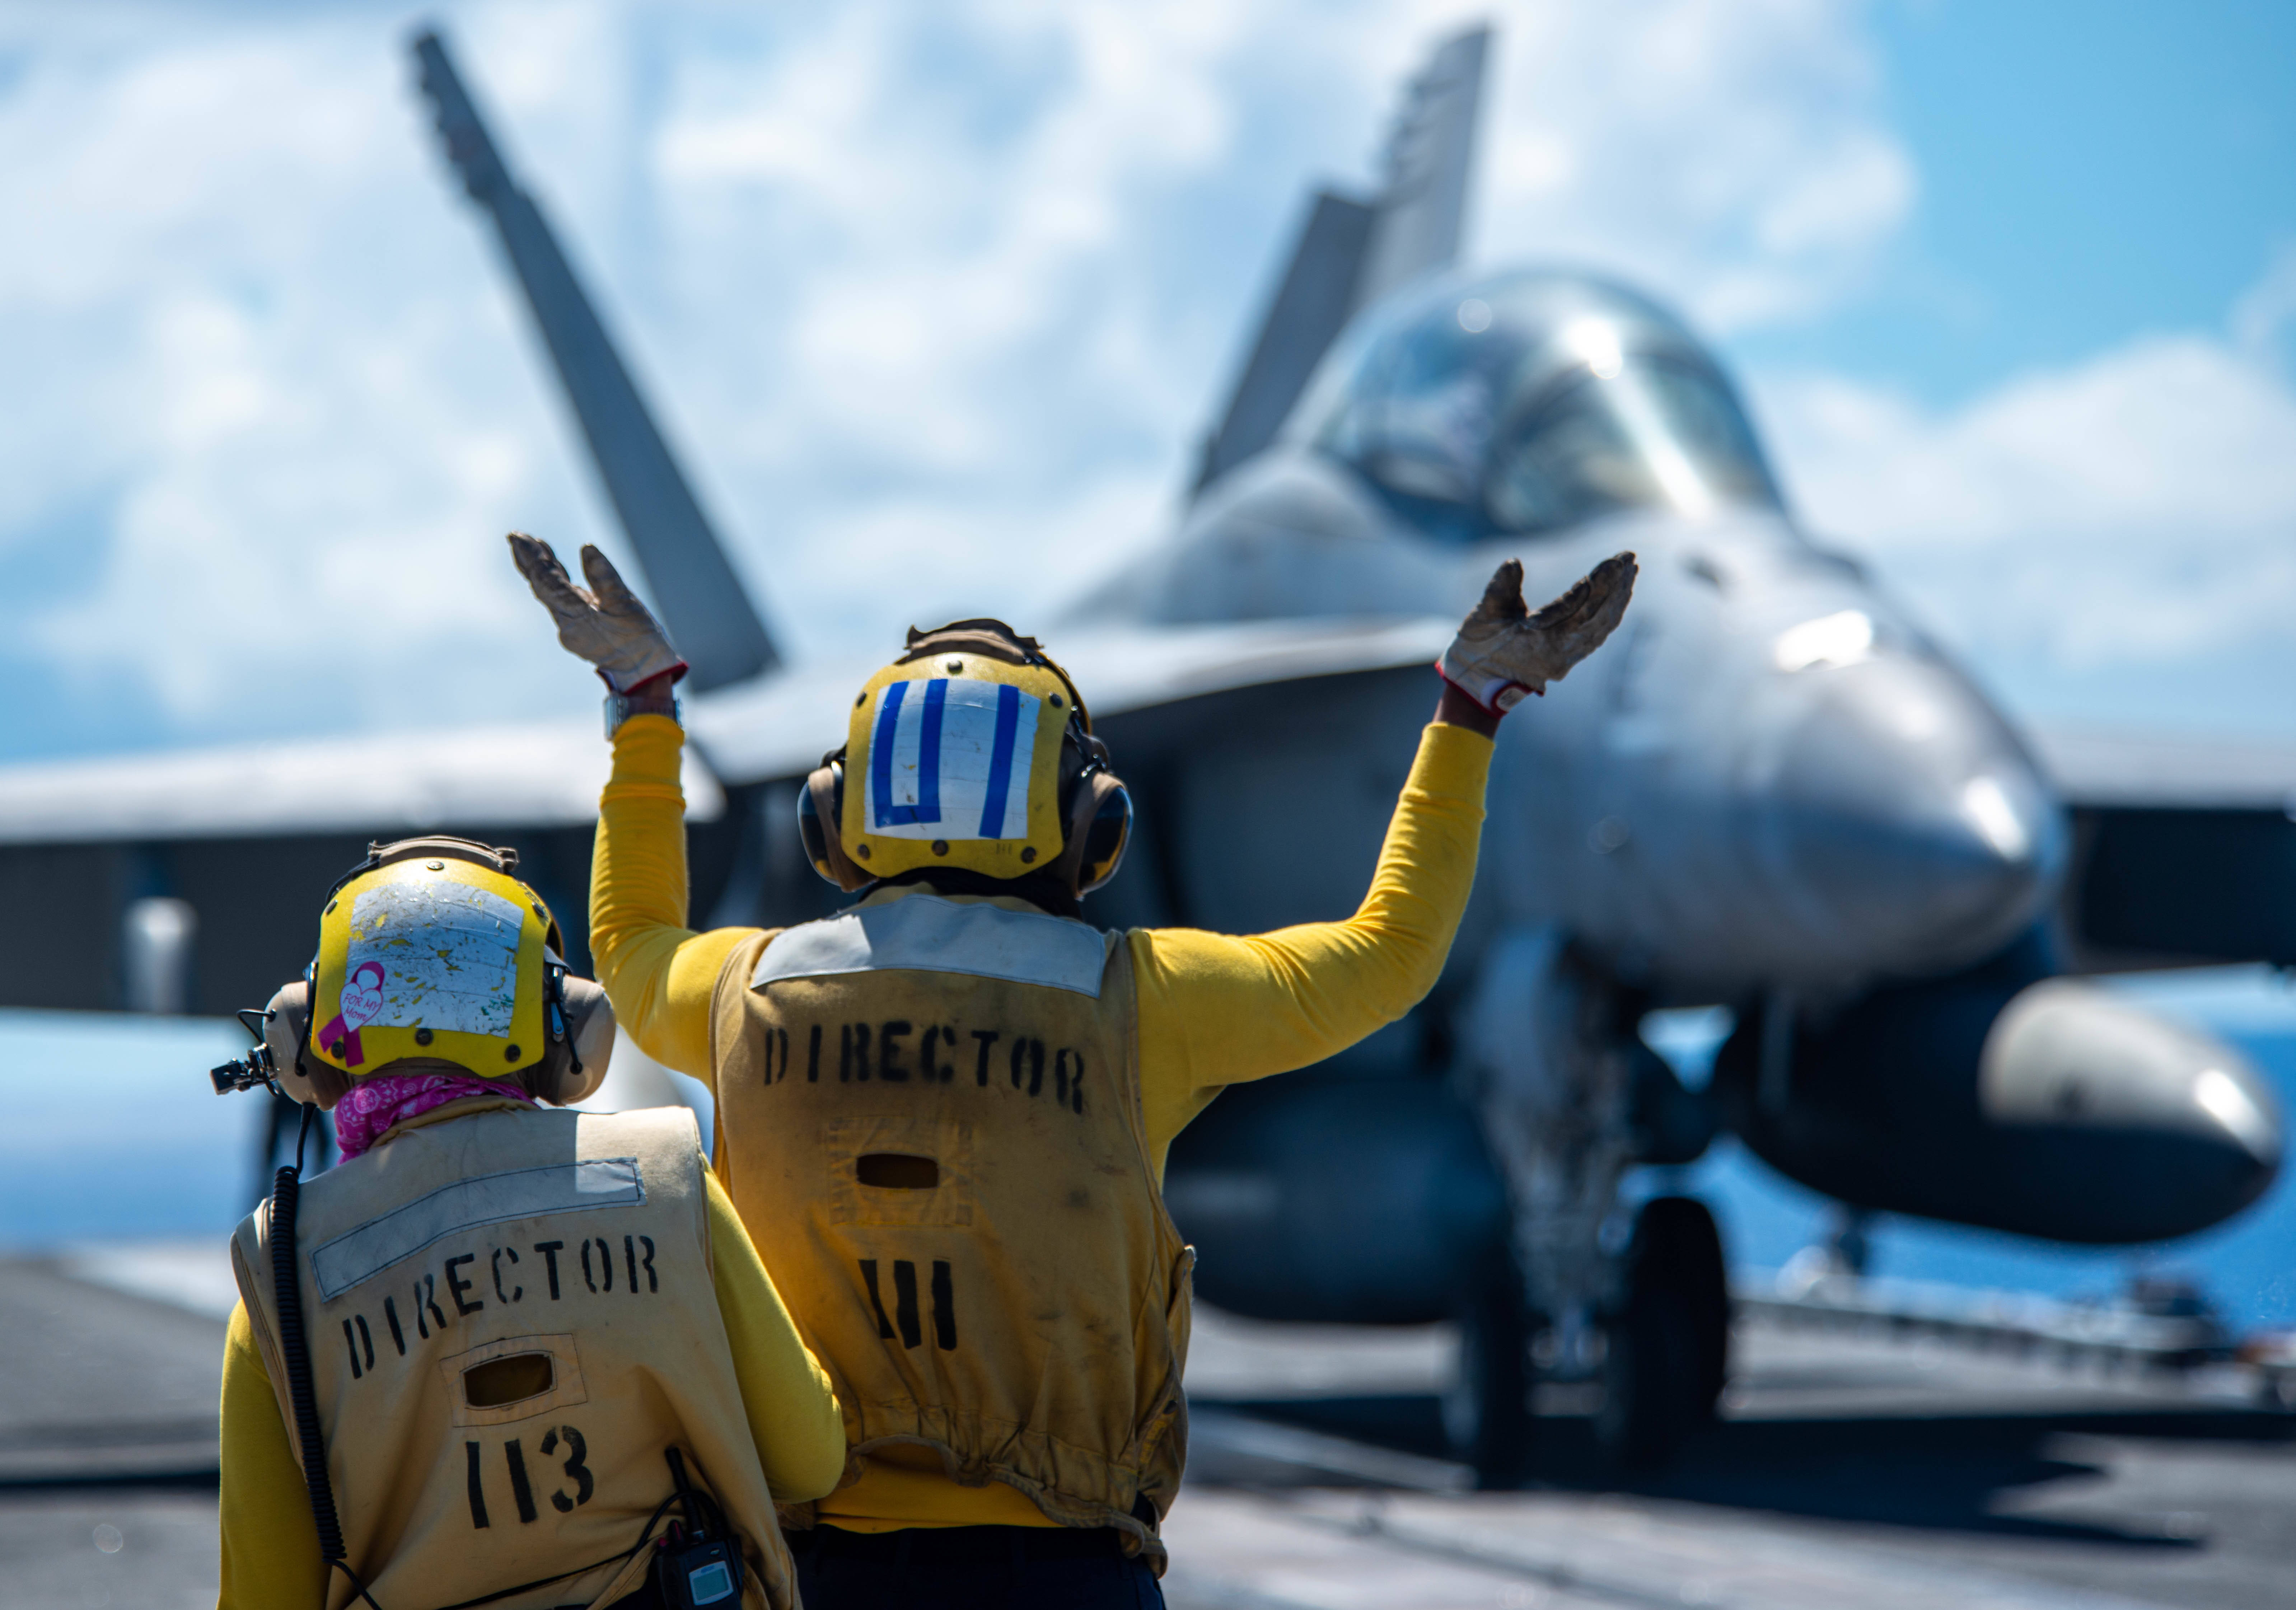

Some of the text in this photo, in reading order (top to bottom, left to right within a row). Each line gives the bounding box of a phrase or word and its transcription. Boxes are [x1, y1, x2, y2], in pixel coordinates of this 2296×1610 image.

[343, 993, 380, 1011] FOR MY
[764, 1020, 1085, 1114] DIRECTOR
[342, 1235, 658, 1380] DIRECTOR
[858, 1259, 957, 1351] 111
[466, 1425, 594, 1529] 113
